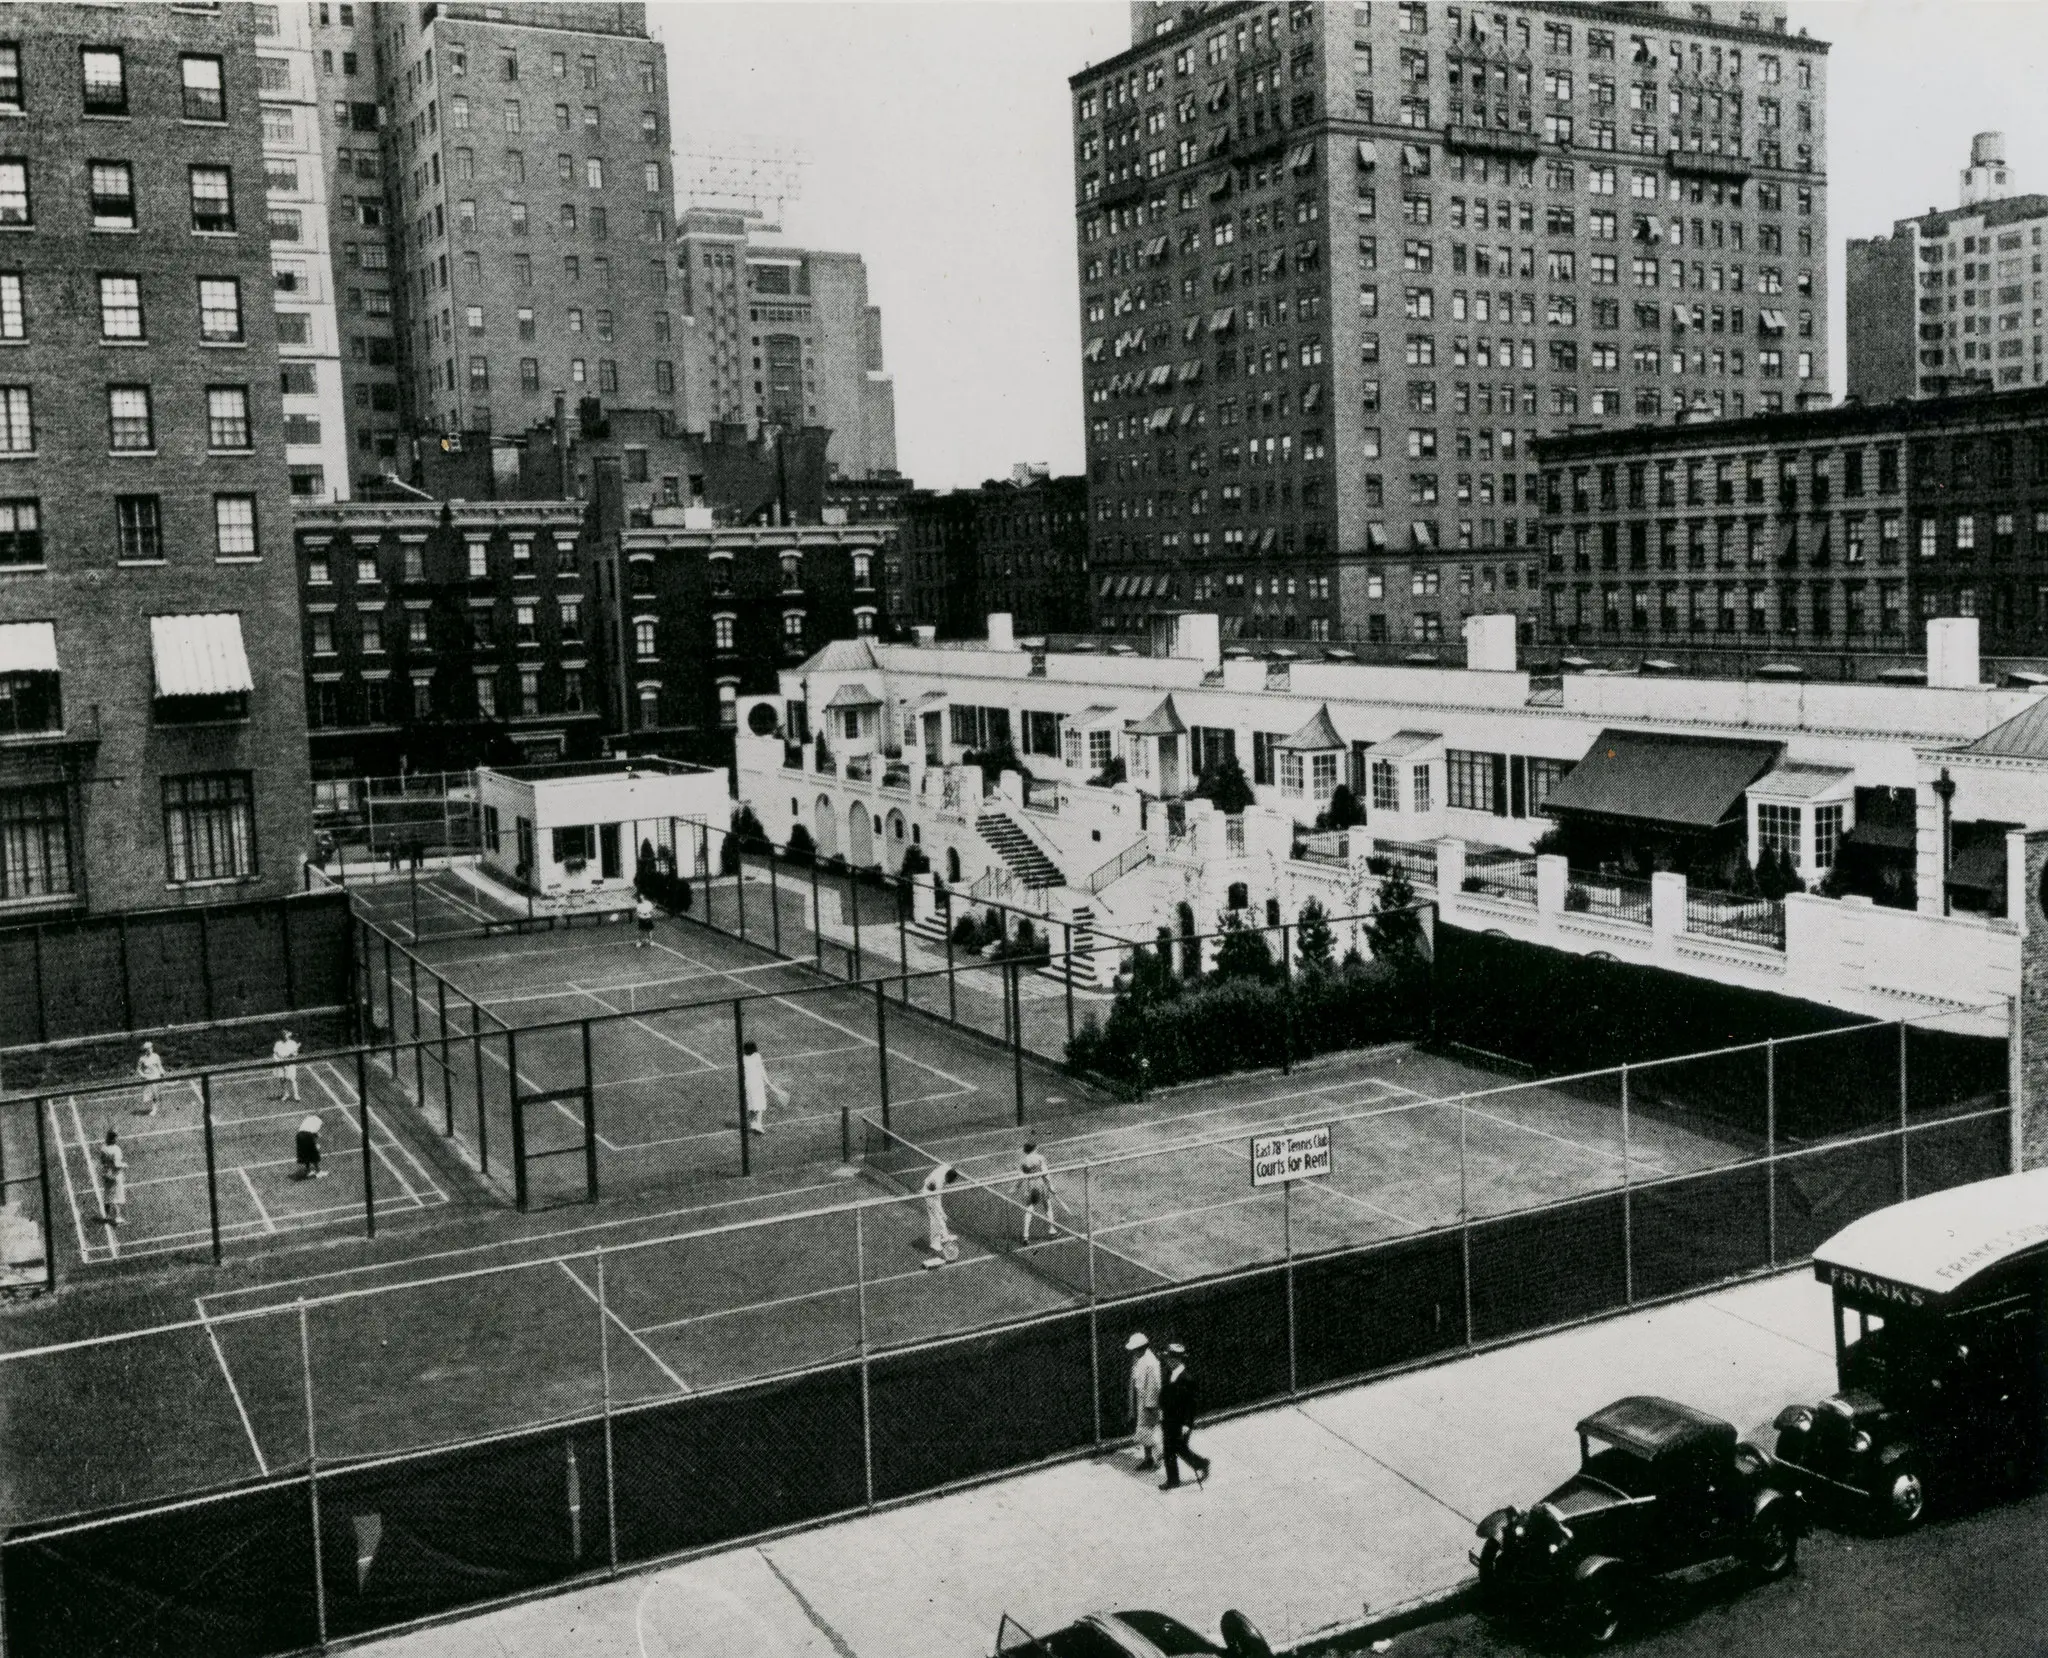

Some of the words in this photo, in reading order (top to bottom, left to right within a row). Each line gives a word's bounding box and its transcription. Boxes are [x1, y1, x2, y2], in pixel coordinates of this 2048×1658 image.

[1256, 1143, 1271, 1158] East
[1287, 1138, 1313, 1153] Tennis
[1313, 1133, 1328, 1148] Club
[1256, 1159, 1285, 1178] Courts
[1287, 1156, 1302, 1172] for
[1304, 1150, 1328, 1170] Rent
